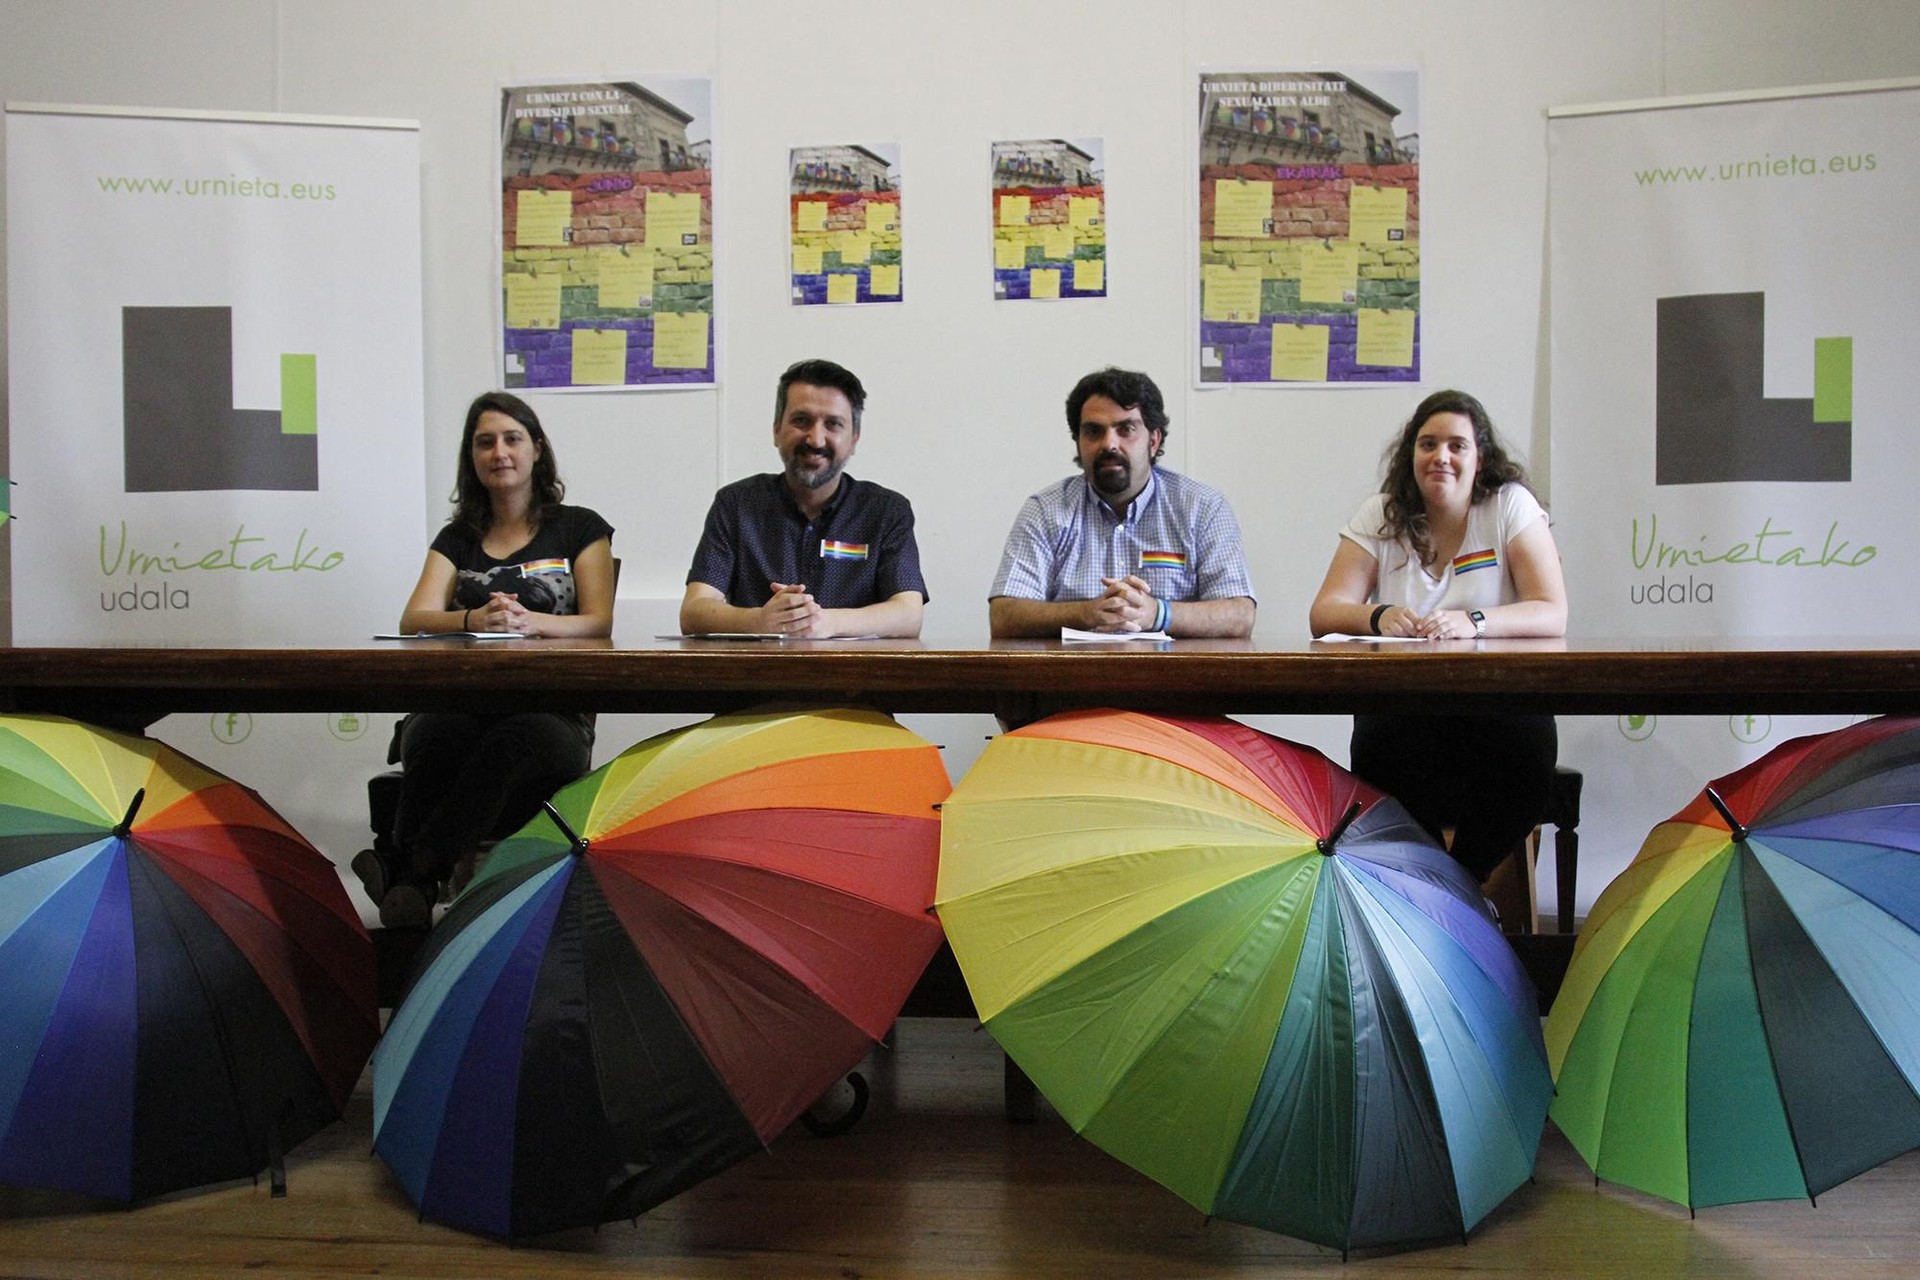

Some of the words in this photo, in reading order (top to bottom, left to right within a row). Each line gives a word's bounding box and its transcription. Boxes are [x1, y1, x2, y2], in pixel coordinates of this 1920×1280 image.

[526, 92, 578, 104] URNIETA
[1202, 82, 1257, 92] URNIETA
[1258, 81, 1347, 92] DIBERTSITATE
[515, 106, 586, 118] DIVERSIDAD
[587, 104, 632, 115] SEXUAL
[1218, 96, 1298, 107] SEXUALAREN
[1300, 96, 1331, 106] ALDE
[1634, 152, 1876, 186] www.urnieta.eus
[98, 173, 336, 201] www.urnieta.eus
[99, 520, 345, 577] Urnietako
[1632, 513, 1878, 571] Urnietako
[100, 582, 189, 612] udala
[1630, 574, 1713, 604] udala
